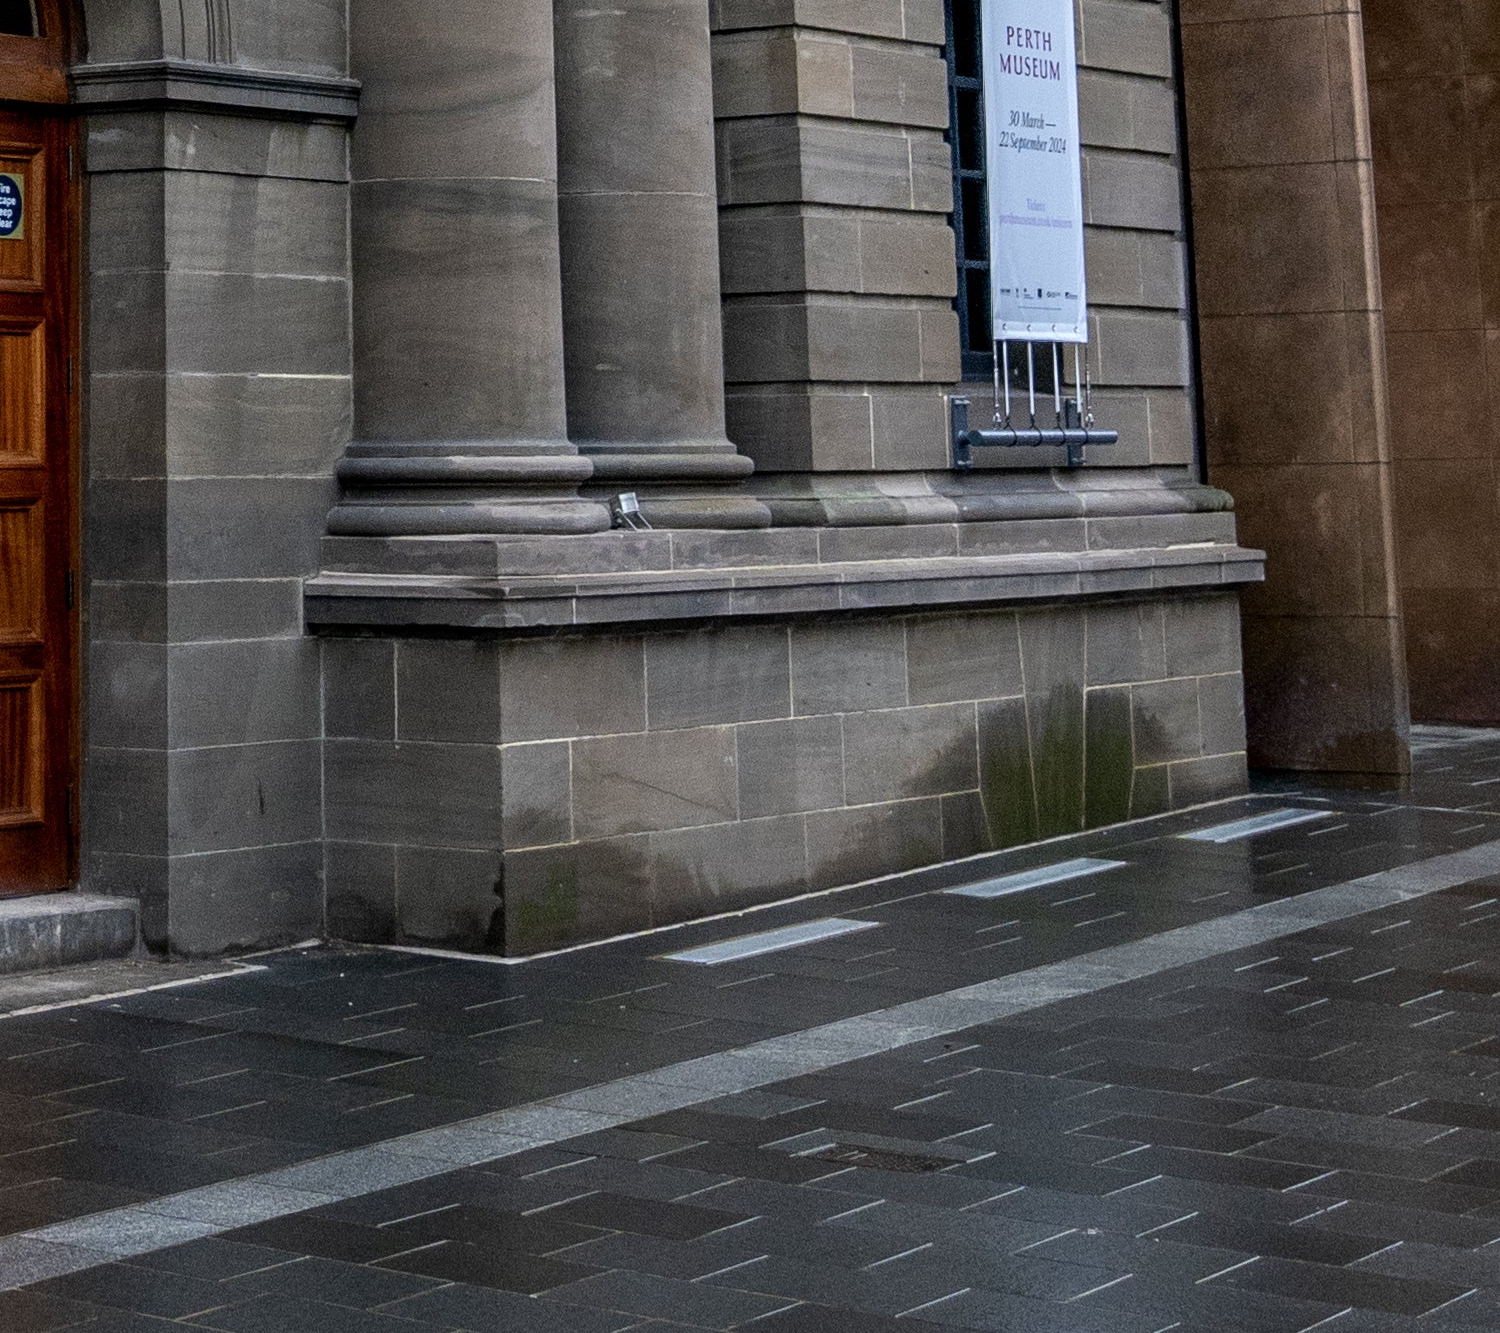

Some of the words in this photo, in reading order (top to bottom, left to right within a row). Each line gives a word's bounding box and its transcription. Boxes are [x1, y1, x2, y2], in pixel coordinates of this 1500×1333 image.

[1006, 25, 1052, 52] PERTH
[999, 53, 1061, 81] MUSEUM
[1008, 110, 1020, 127] 30
[1020, 112, 1045, 130] March
[999, 131, 1010, 148] 22
[1010, 133, 1048, 154] September
